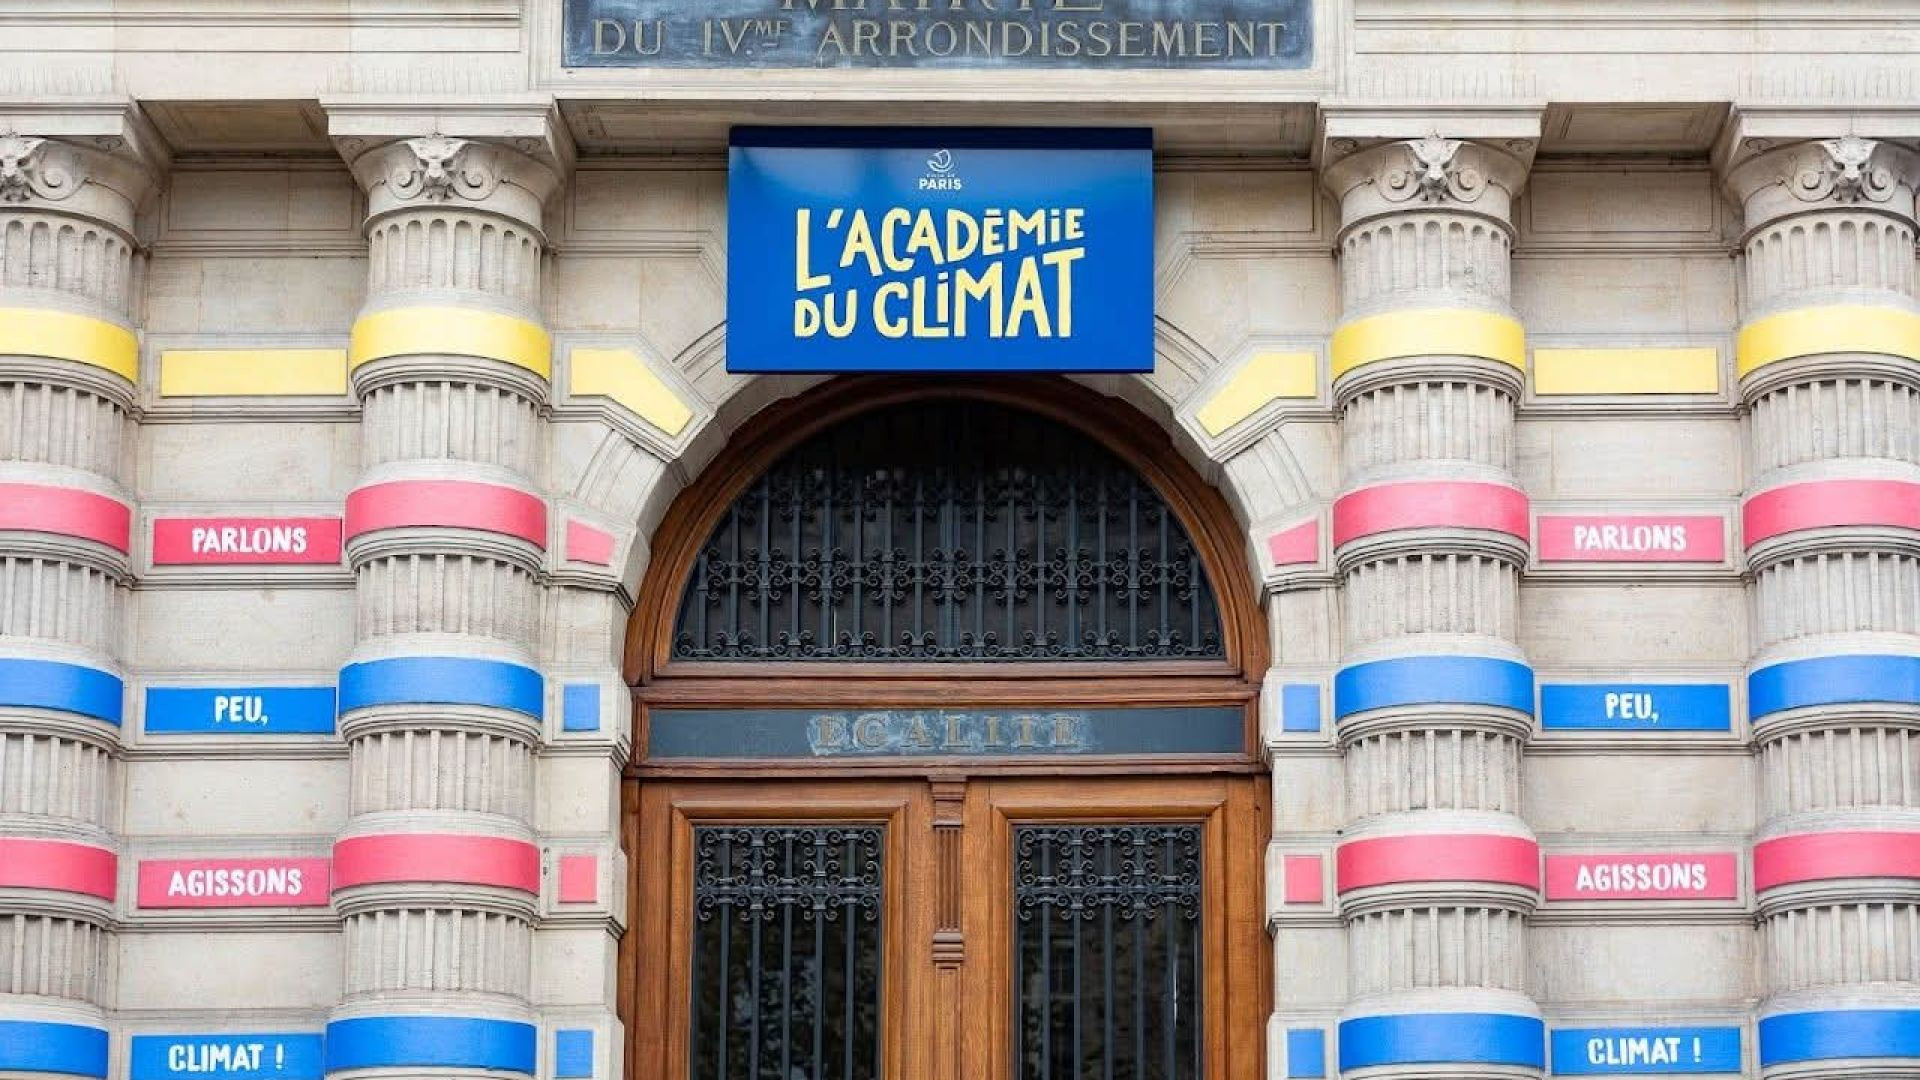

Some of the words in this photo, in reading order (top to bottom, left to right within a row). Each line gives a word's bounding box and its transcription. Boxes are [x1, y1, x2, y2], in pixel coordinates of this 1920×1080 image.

[592, 19, 665, 55] DU
[816, 20, 1288, 57] ARRONDISSEMENT
[919, 178, 962, 190] PARIS
[794, 288, 857, 338] DU
[191, 526, 308, 554] PARLONS
[1573, 524, 1688, 552] PARLONS
[214, 695, 269, 725] PEU,
[1604, 692, 1660, 723] PEU,
[167, 867, 303, 897] AGISSONS
[1575, 862, 1708, 892] AGISSONS
[168, 1043, 264, 1072] CLIMAT
[1586, 1036, 1681, 1065] CLIMAT
